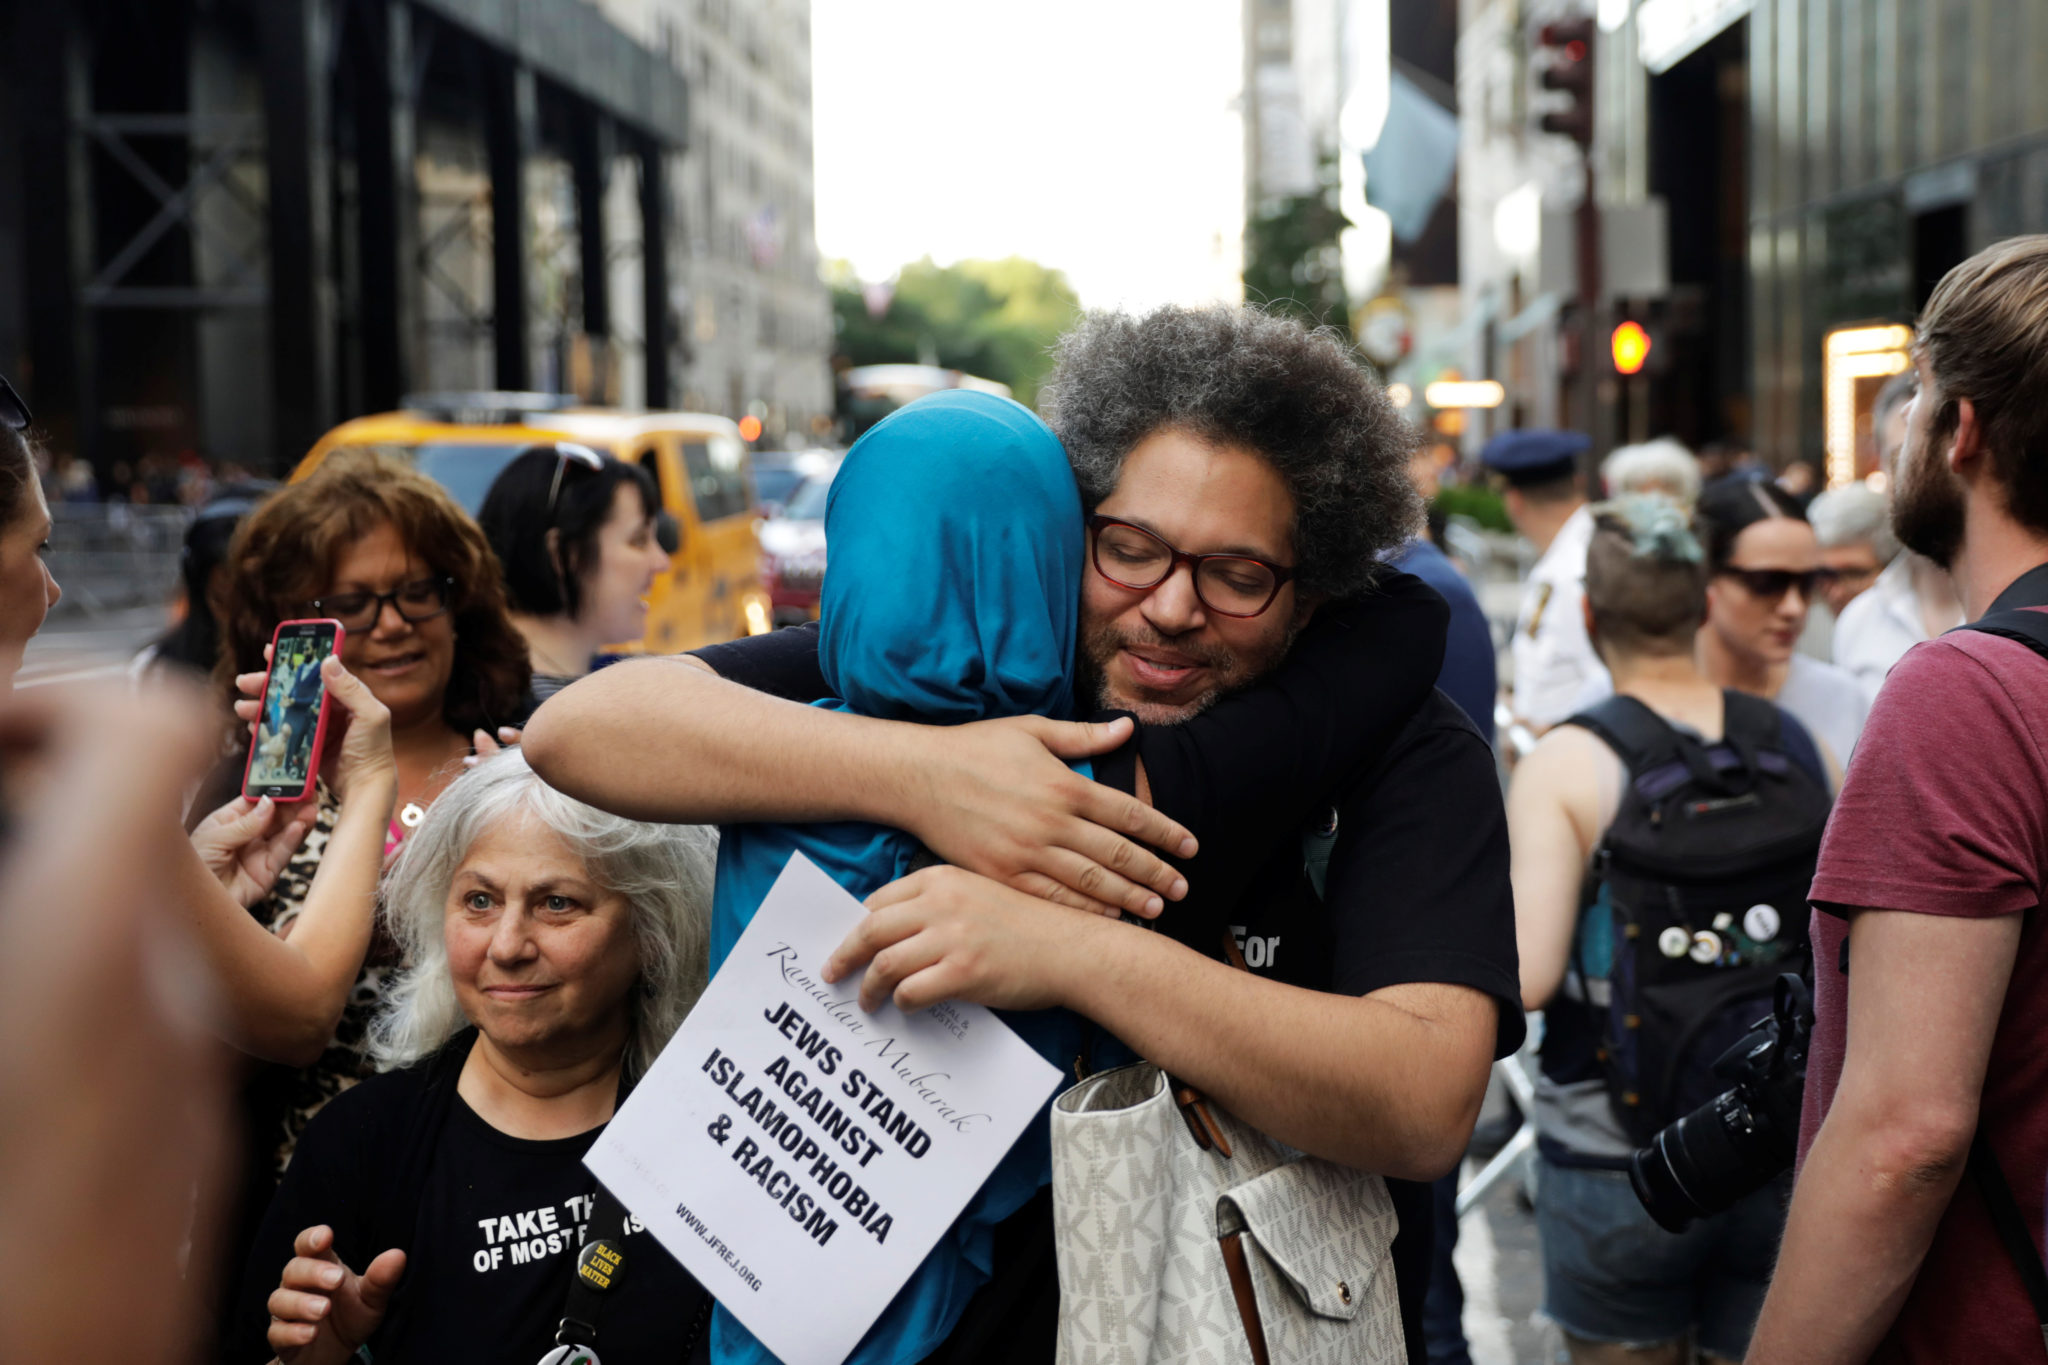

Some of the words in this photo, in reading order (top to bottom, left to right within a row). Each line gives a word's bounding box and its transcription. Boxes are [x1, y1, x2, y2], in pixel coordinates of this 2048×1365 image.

[764, 941, 866, 1035] Ramadan
[864, 1036, 993, 1134] Mubarak
[764, 1001, 843, 1075] JEWS
[841, 1069, 931, 1159] STAND
[701, 1047, 894, 1245] ISLAMOPHOBIA
[764, 1055, 884, 1168] AGAINST
[707, 1114, 730, 1147] &
[731, 1140, 839, 1247] RACISM
[473, 1247, 503, 1273] OF
[510, 1228, 574, 1265] MOST
[478, 1207, 559, 1245] TAKE
[590, 1255, 614, 1276] LIVES
[595, 1243, 622, 1266] BLACK
[676, 1202, 763, 1292] WWW.JFREJ.ORG
[580, 1263, 611, 1289] MATTER
